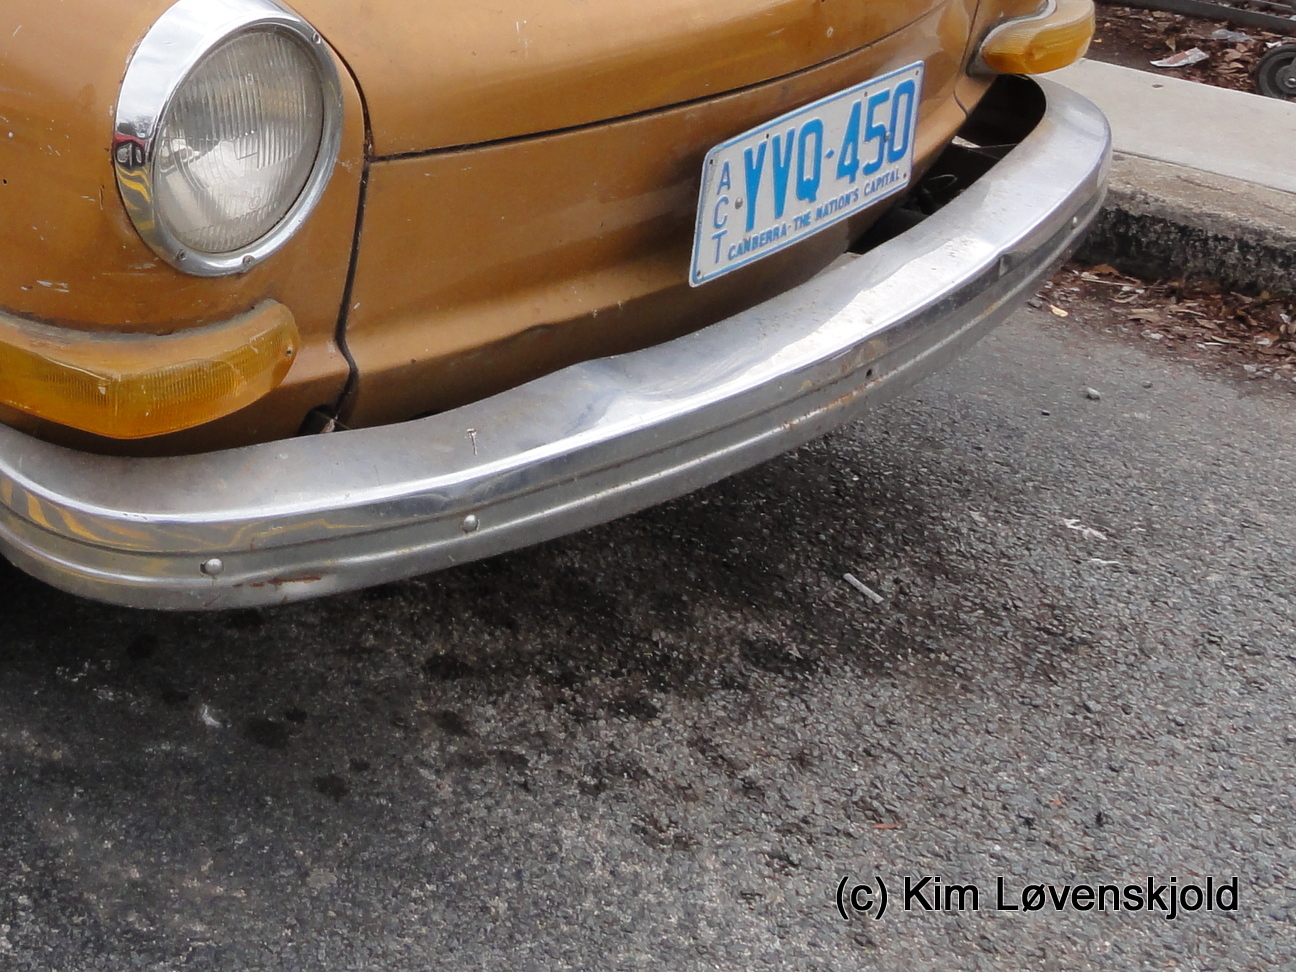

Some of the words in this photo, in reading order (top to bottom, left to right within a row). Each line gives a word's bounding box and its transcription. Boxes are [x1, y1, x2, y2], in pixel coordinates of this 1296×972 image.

[728, 223, 788, 261] CANBERRA
[793, 211, 812, 231] THE
[815, 188, 860, 221] NATION'S
[863, 168, 900, 197] CAPITAL
